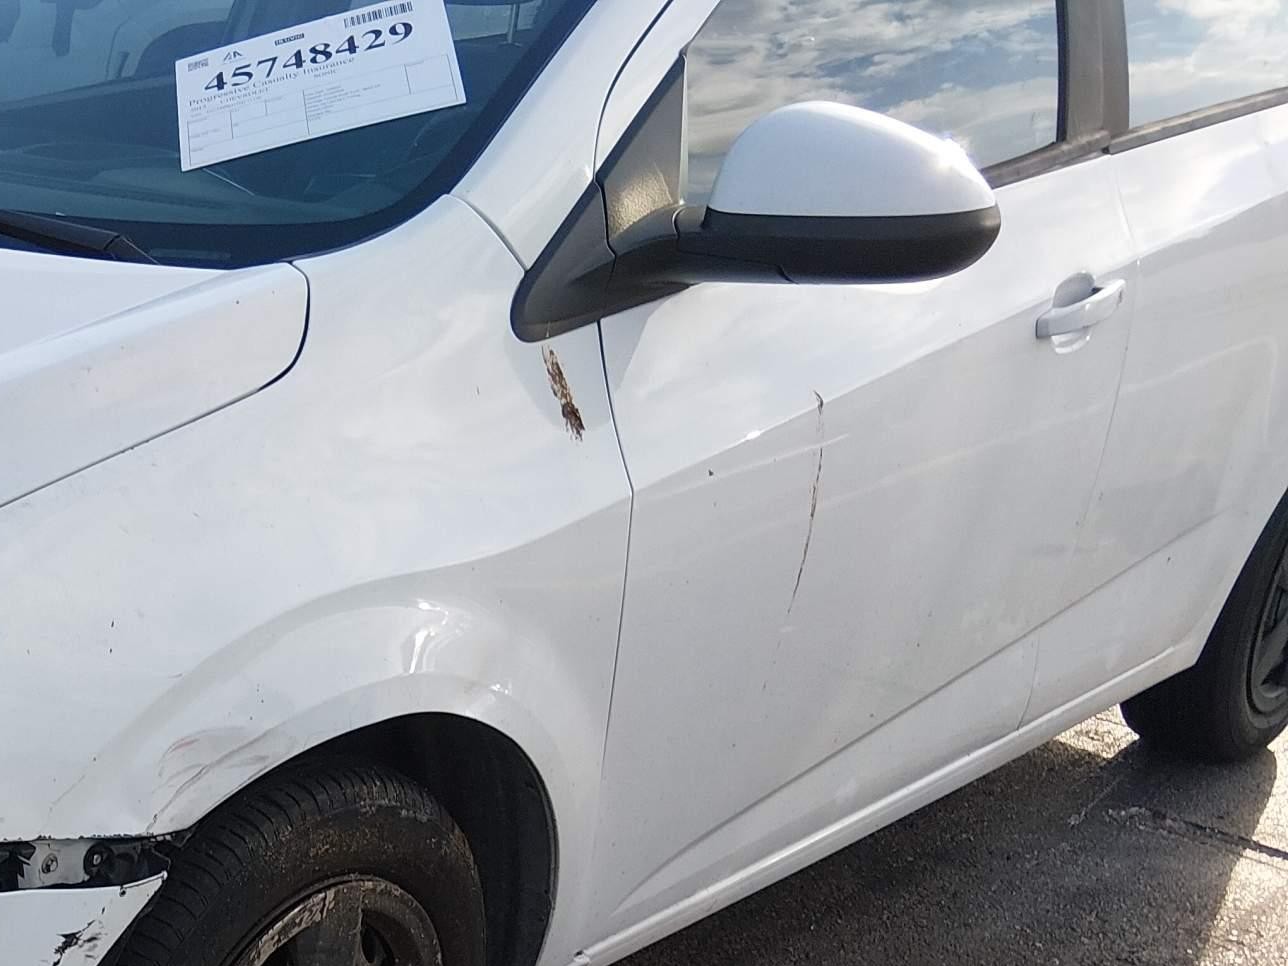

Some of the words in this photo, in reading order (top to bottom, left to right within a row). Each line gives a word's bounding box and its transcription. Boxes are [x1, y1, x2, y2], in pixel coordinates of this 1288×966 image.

[189, 86, 250, 107] Progressive
[253, 71, 298, 89] Casualty
[303, 57, 355, 74] Insurance
[204, 21, 414, 91] 45748429
